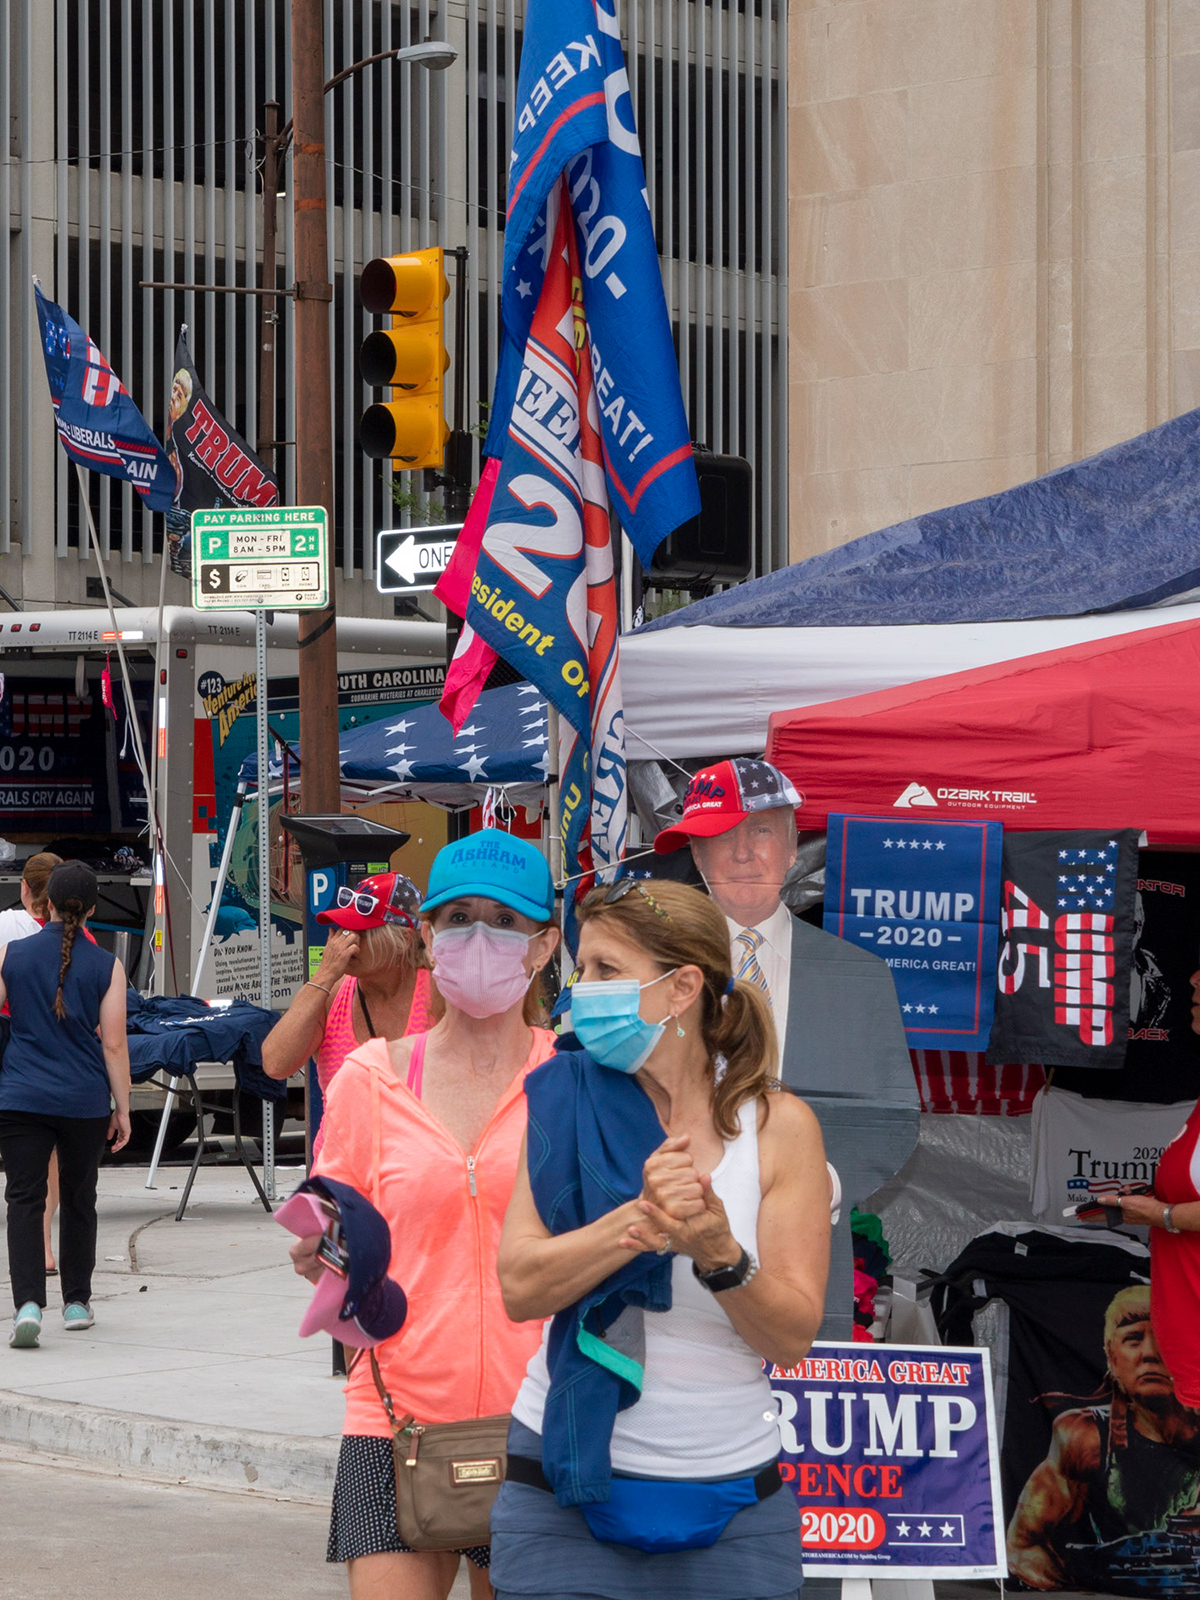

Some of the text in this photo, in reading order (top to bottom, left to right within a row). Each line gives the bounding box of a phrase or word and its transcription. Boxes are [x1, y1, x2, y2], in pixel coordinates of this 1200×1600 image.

[70, 424, 116, 450] LIBERALS
[184, 398, 279, 508] TRUM
[203, 512, 315, 524] PAY PARKING HERE
[208, 537, 221, 554] P
[236, 535, 257, 543] MON
[294, 535, 306, 552] 2
[419, 546, 453, 569] ONE
[68, 631, 76, 640] TT
[208, 624, 218, 635] TT
[200, 677, 222, 694] #123
[372, 668, 445, 688] CAROLINA
[32, 789, 55, 805] CRY
[56, 789, 95, 805] AGAIN
[480, 841, 500, 849] THE
[451, 848, 526, 870] ASHRAM
[455, 860, 519, 874] ICELAND
[312, 872, 329, 907] P
[850, 888, 975, 921] TRUMP
[224, 946, 235, 955] YOU
[1054, 839, 1120, 1046] TRUMP
[885, 958, 976, 971] MERICA GREAT!
[216, 984, 234, 995] LEARN
[1067, 1193, 1088, 1203] Make
[770, 1357, 971, 1386] AMERICA GREAT
[771, 1389, 978, 1459] RUMP
[778, 1462, 904, 1499] PENCE
[801, 1512, 876, 1544] 2020
